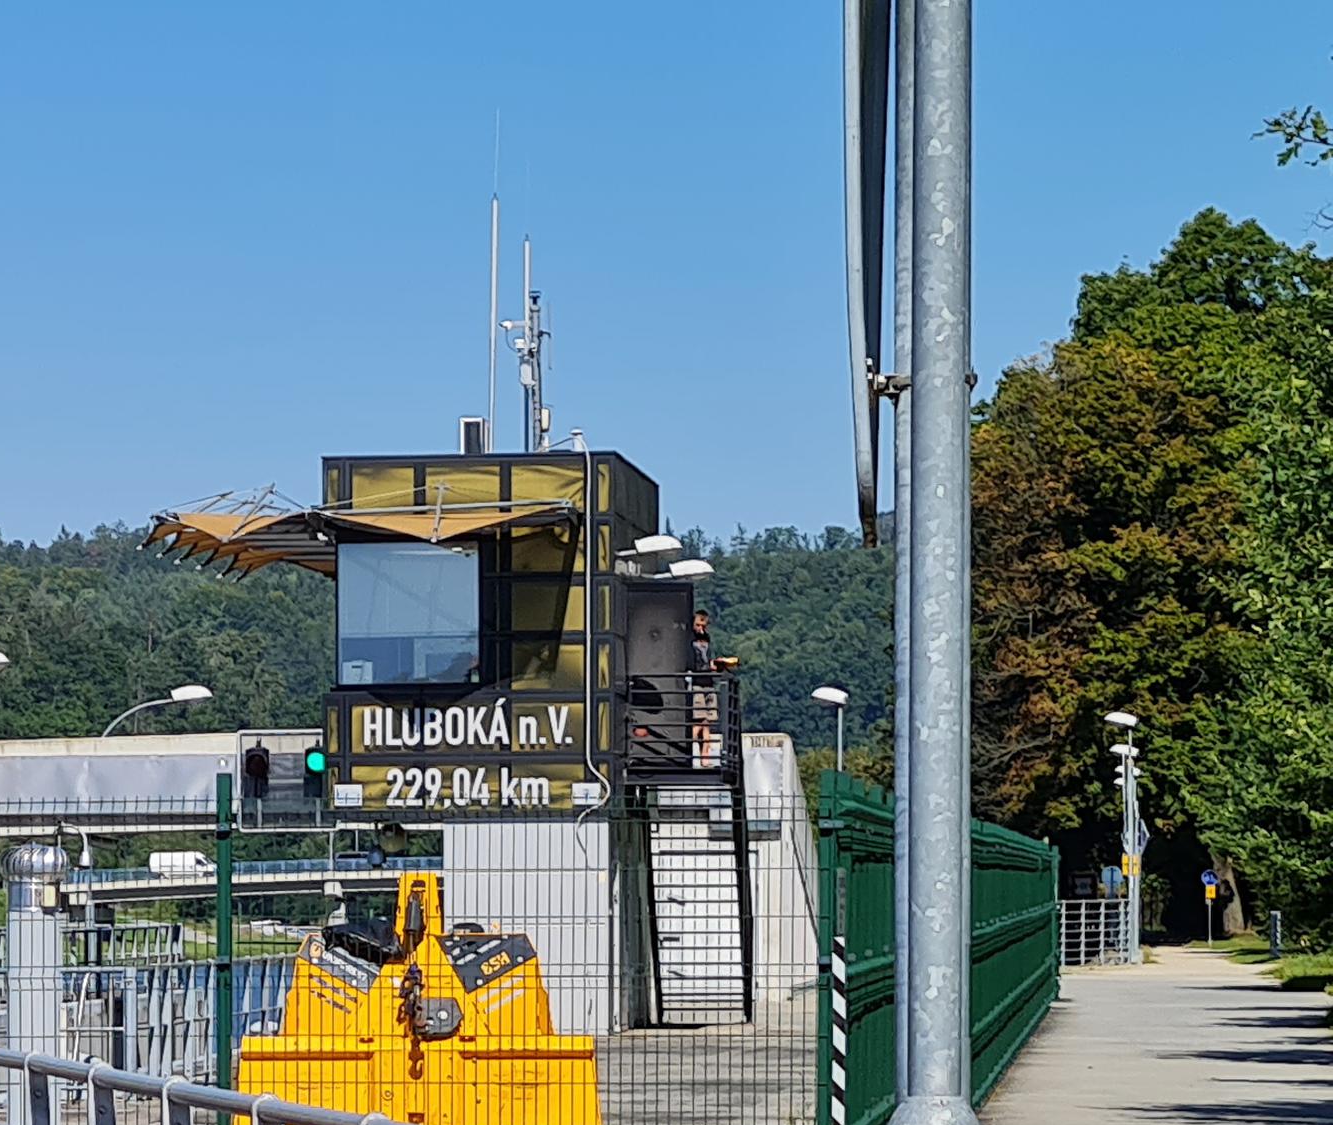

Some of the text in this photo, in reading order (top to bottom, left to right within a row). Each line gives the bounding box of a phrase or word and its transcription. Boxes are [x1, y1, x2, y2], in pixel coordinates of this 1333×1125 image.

[362, 697, 510, 746] HLUBOKÁ
[385, 766, 491, 808] 229,04
[500, 766, 550, 806] km
